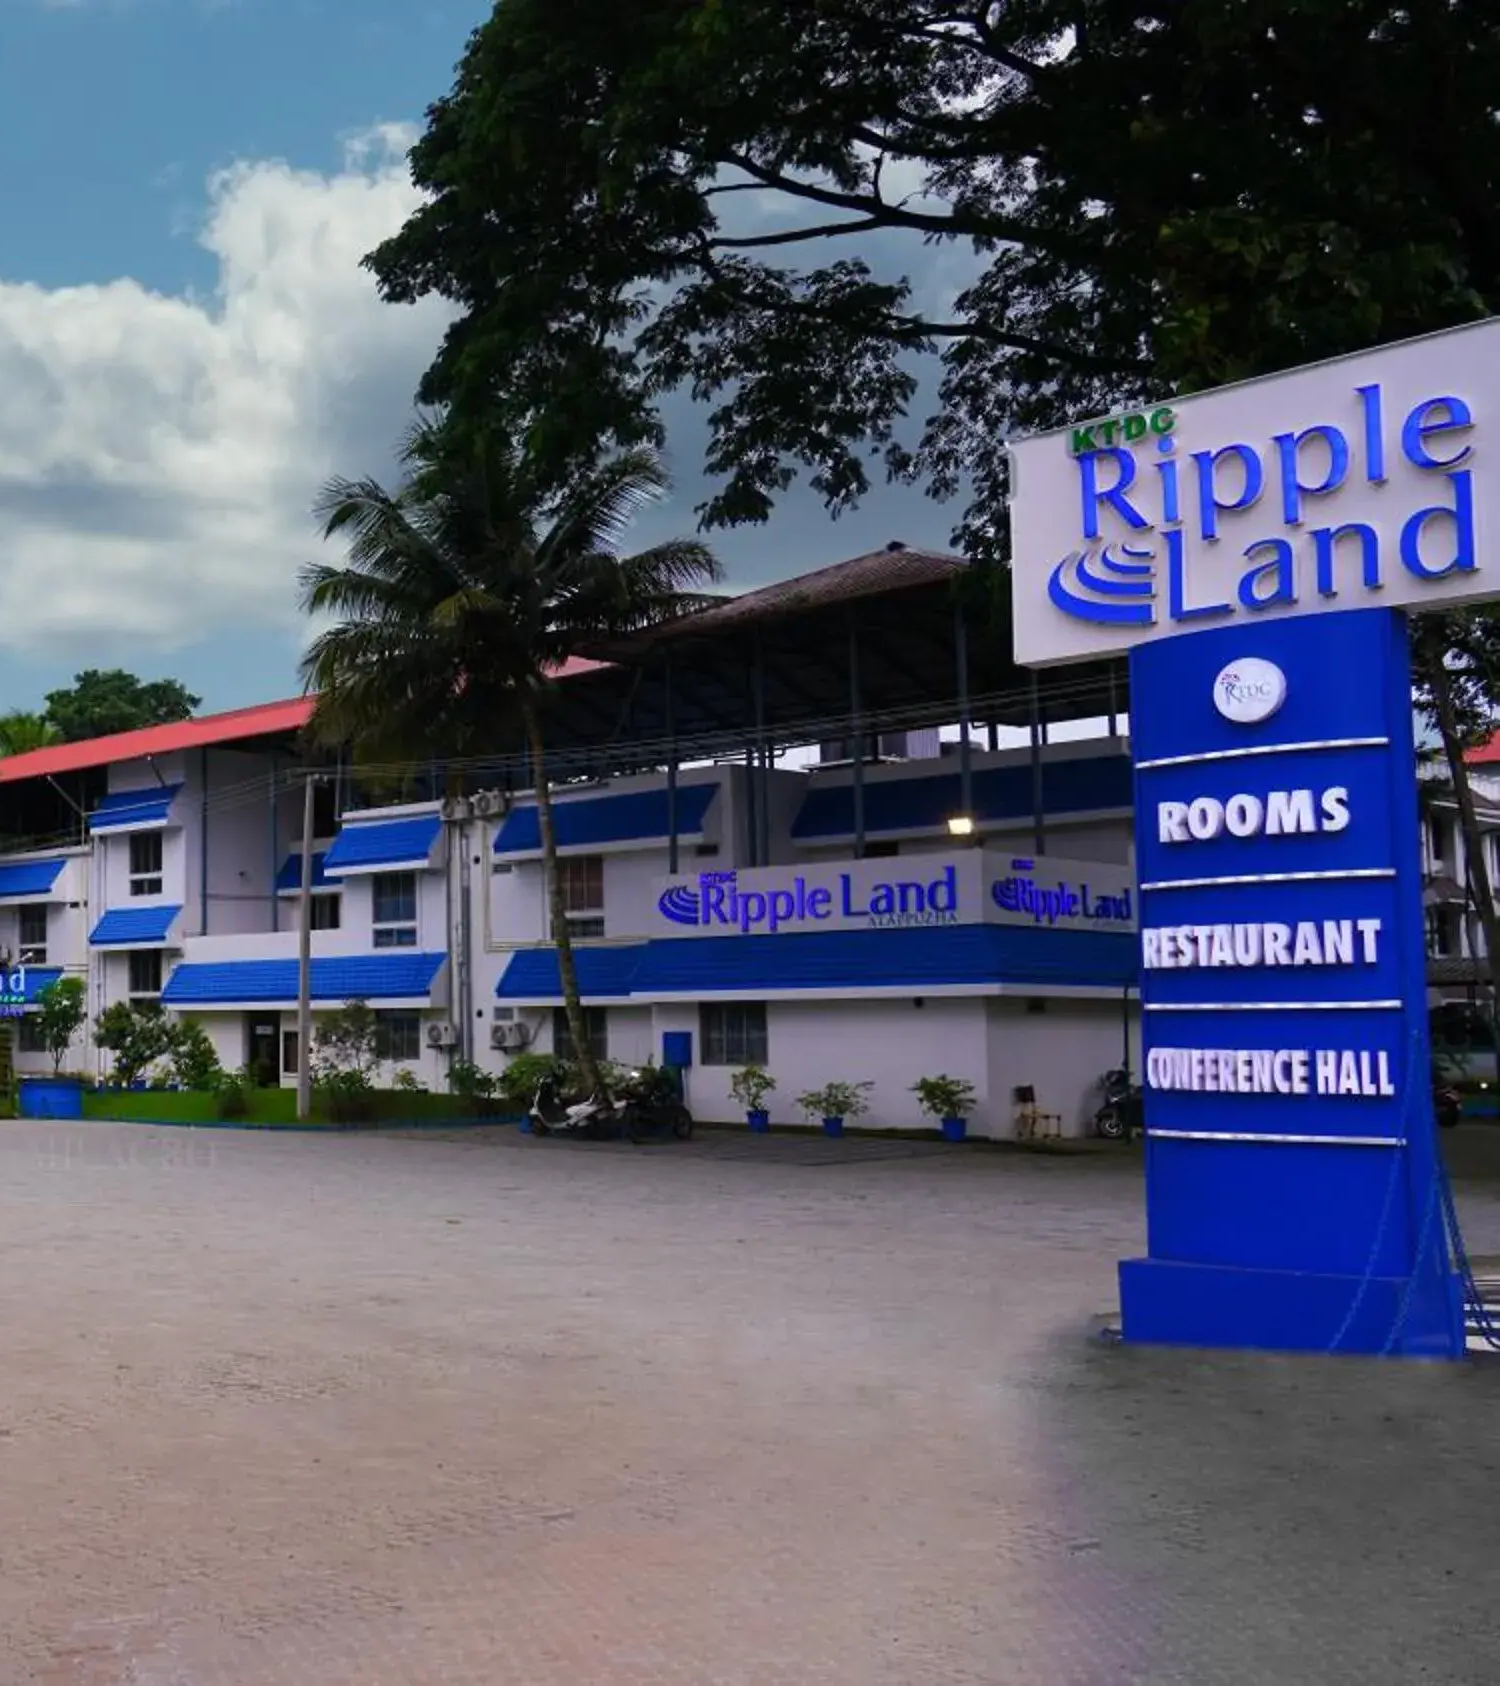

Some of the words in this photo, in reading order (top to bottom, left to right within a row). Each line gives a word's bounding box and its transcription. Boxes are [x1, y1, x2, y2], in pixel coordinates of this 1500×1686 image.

[1072, 407, 1175, 453] KTDC
[1075, 382, 1477, 541] Ripple
[1161, 469, 1479, 621] Land
[1157, 785, 1351, 843] ROOMS
[701, 877, 832, 932] Ripple
[840, 864, 958, 917] Land
[1011, 877, 1080, 924] Ripple
[1079, 882, 1133, 920] Land
[1142, 919, 1382, 970] RESTAURANT
[1147, 1047, 1309, 1095] CONFERENCE
[1315, 1050, 1395, 1096] HALL
